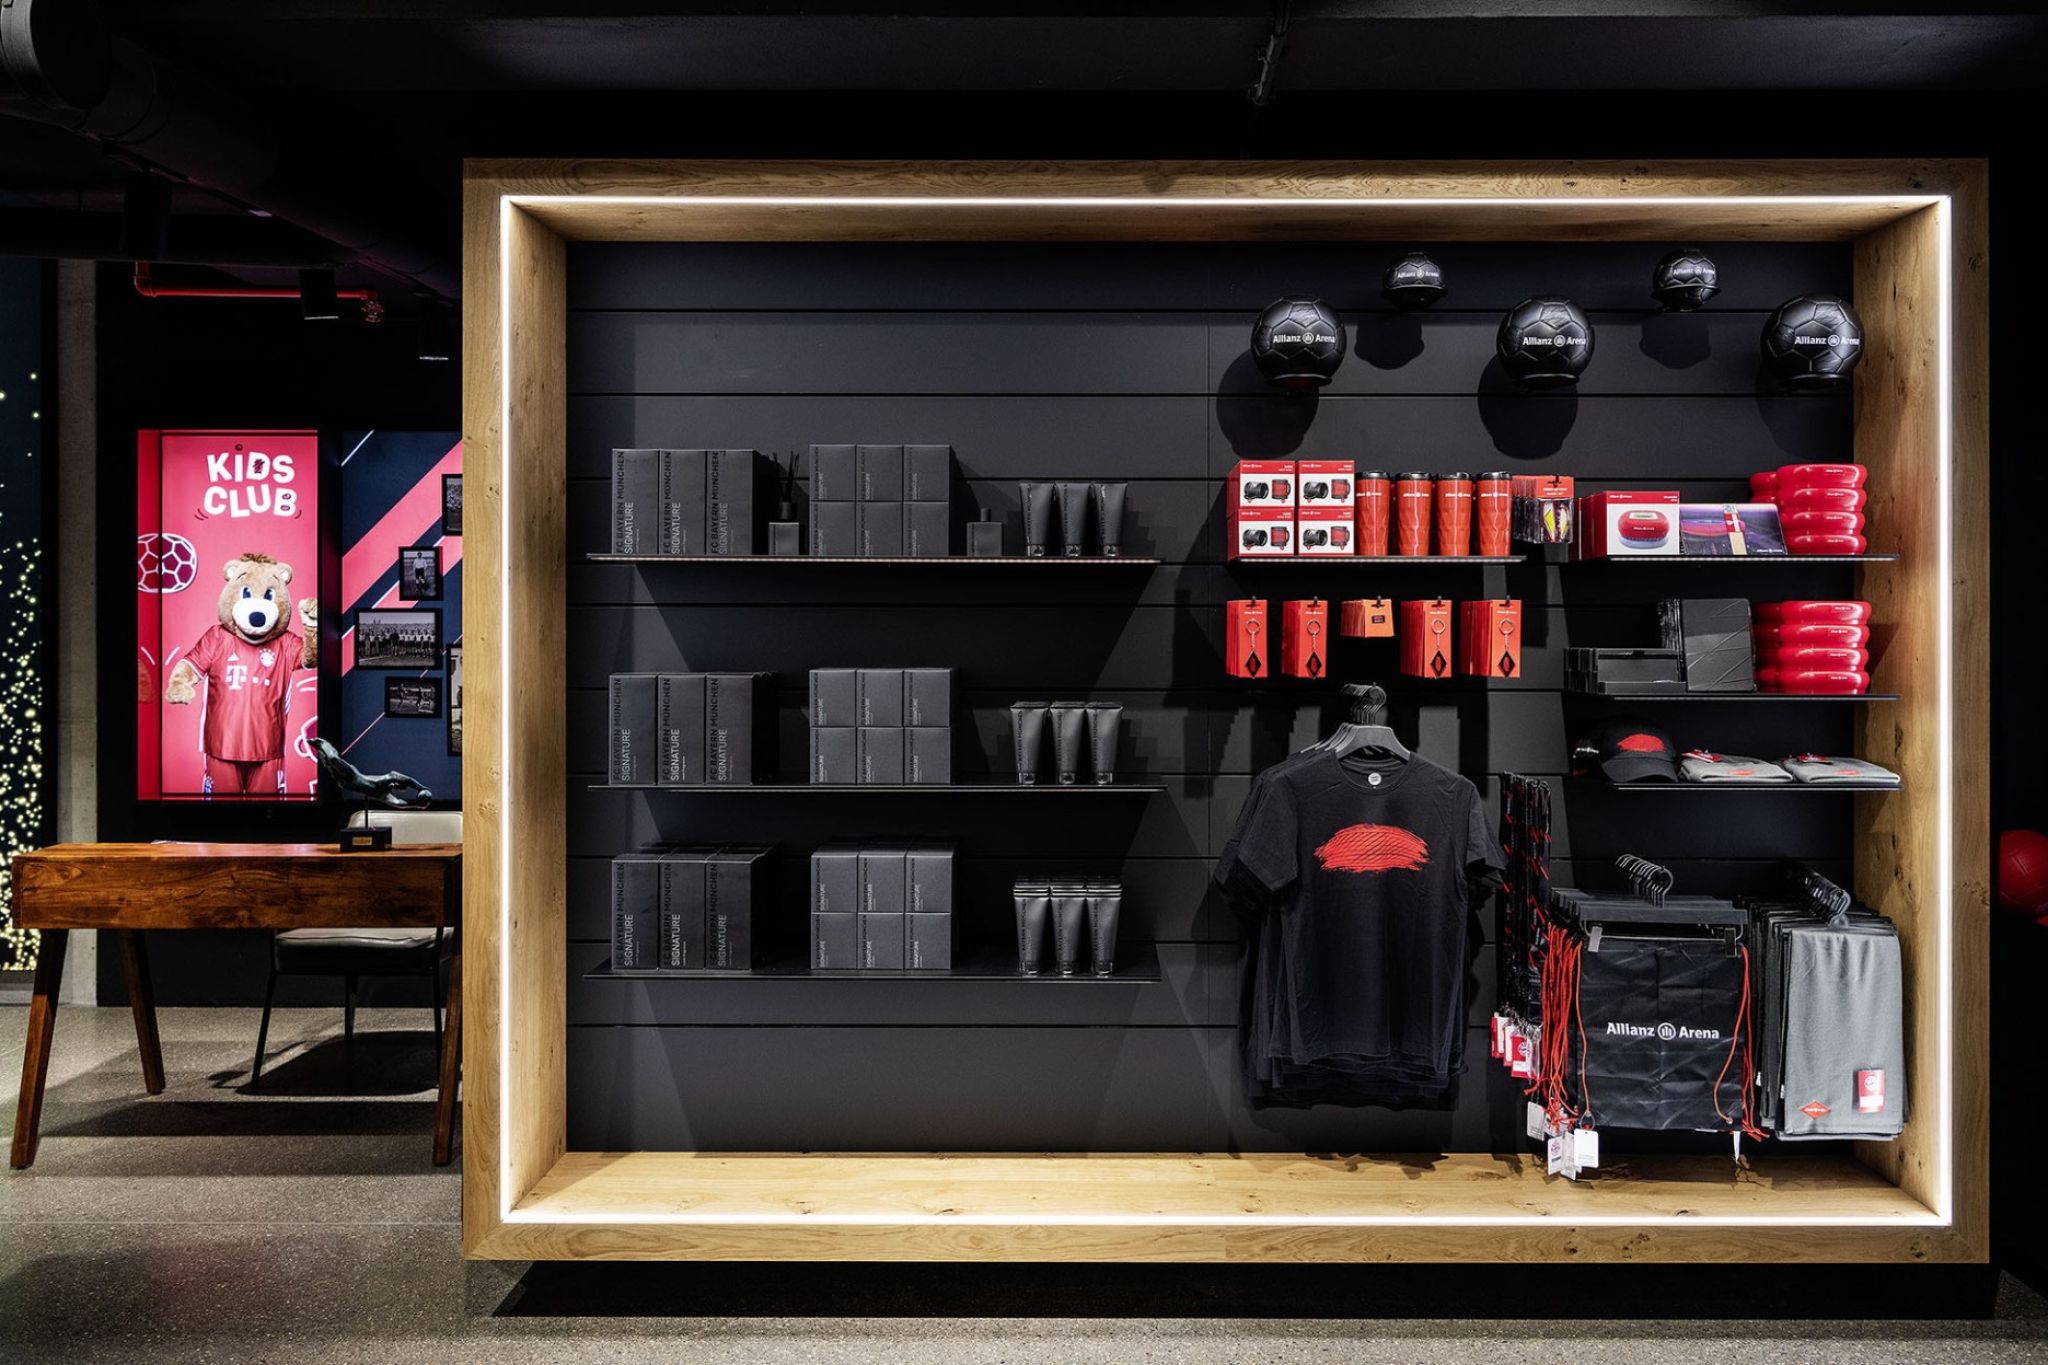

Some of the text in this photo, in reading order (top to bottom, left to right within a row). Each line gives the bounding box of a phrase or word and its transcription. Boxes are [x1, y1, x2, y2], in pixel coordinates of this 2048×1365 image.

[1273, 333, 1335, 343] Allianz Arena
[1522, 336, 1587, 345] Allianz Arena
[1795, 335, 1827, 345] Allianz
[203, 483, 297, 518] CLUB
[616, 502, 624, 538] BAYERN
[625, 502, 633, 554] SIGNATURE
[672, 502, 680, 554] SIGNATURE
[719, 503, 728, 554] SIGNATURE
[622, 729, 631, 781] SIGNATURE
[671, 730, 679, 781] SIGNATURE
[718, 730, 727, 781] SIGNATURE
[625, 914, 633, 966] SIGNATURE
[672, 914, 680, 966] SIGNATURE
[718, 915, 727, 966] SIGNATURE
[1606, 1022, 1719, 1039] Allianz Arena
